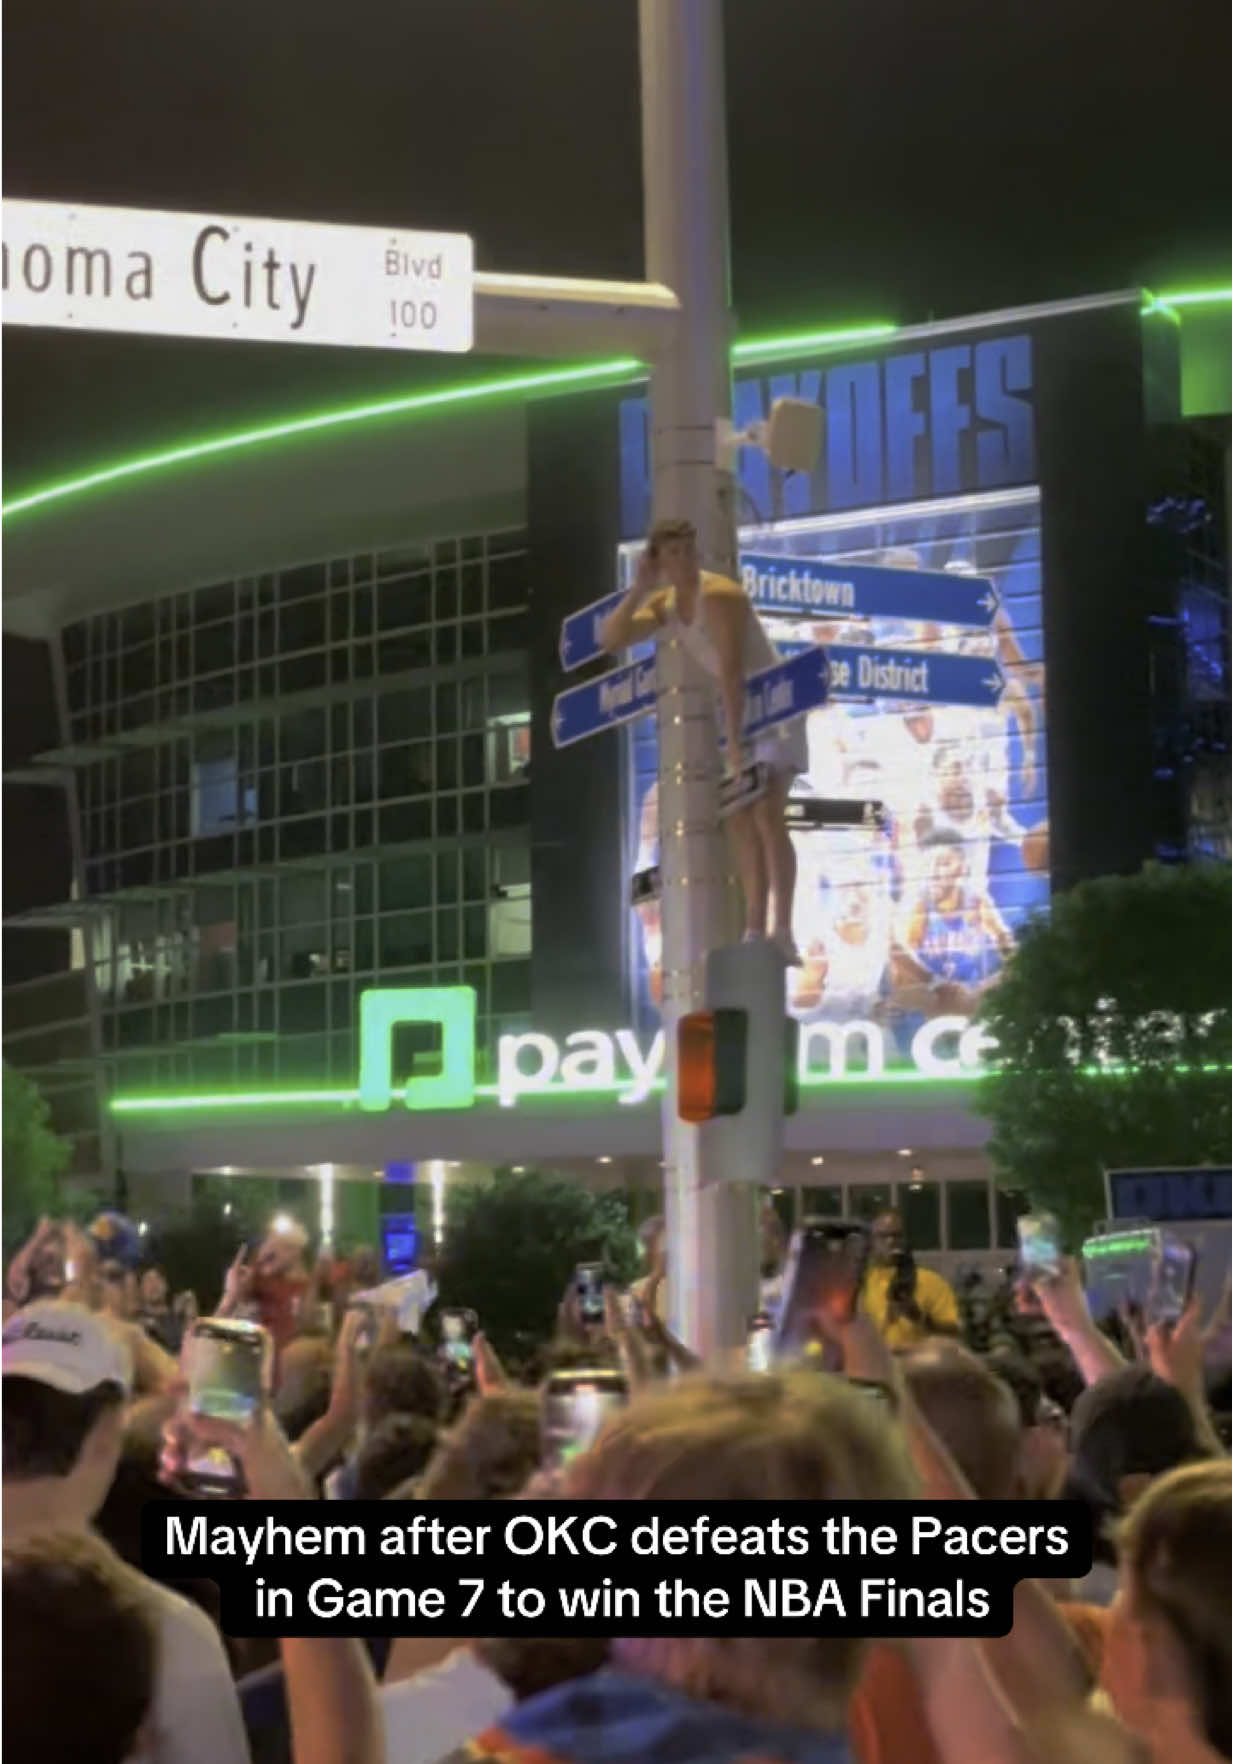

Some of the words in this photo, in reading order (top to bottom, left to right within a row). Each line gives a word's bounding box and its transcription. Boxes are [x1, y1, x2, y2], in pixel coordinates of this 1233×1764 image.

[192, 224, 316, 330] City
[384, 249, 444, 280] Blvd
[389, 299, 438, 330] 100
[741, 563, 855, 608] Bricktown
[857, 654, 930, 693] District
